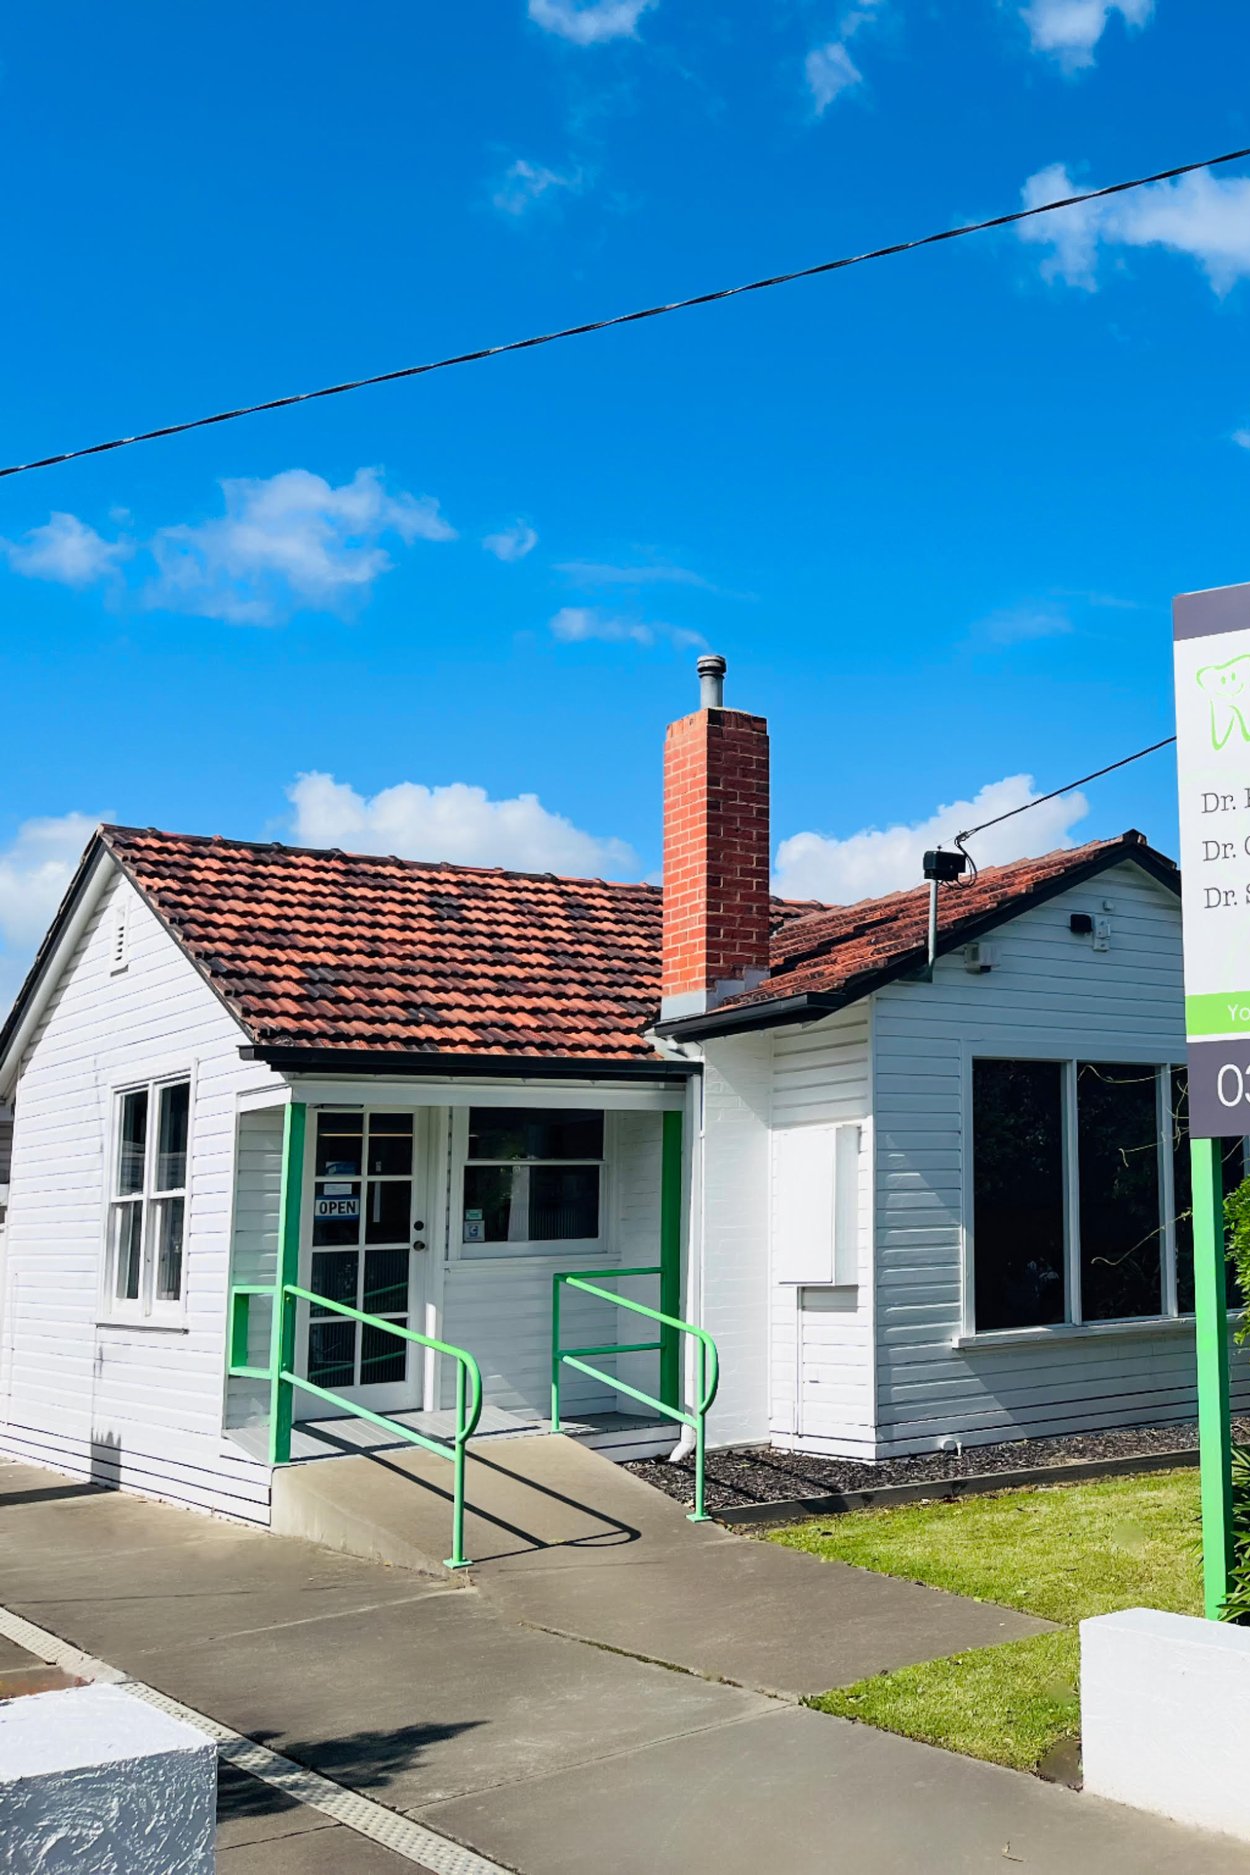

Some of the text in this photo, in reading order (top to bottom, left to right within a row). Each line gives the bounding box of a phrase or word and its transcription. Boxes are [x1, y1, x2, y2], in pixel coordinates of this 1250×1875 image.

[1201, 790, 1237, 815] Dr.
[1202, 839, 1237, 862] Dr.
[1203, 886, 1238, 910] Dr.
[319, 1201, 356, 1215] OPEN
